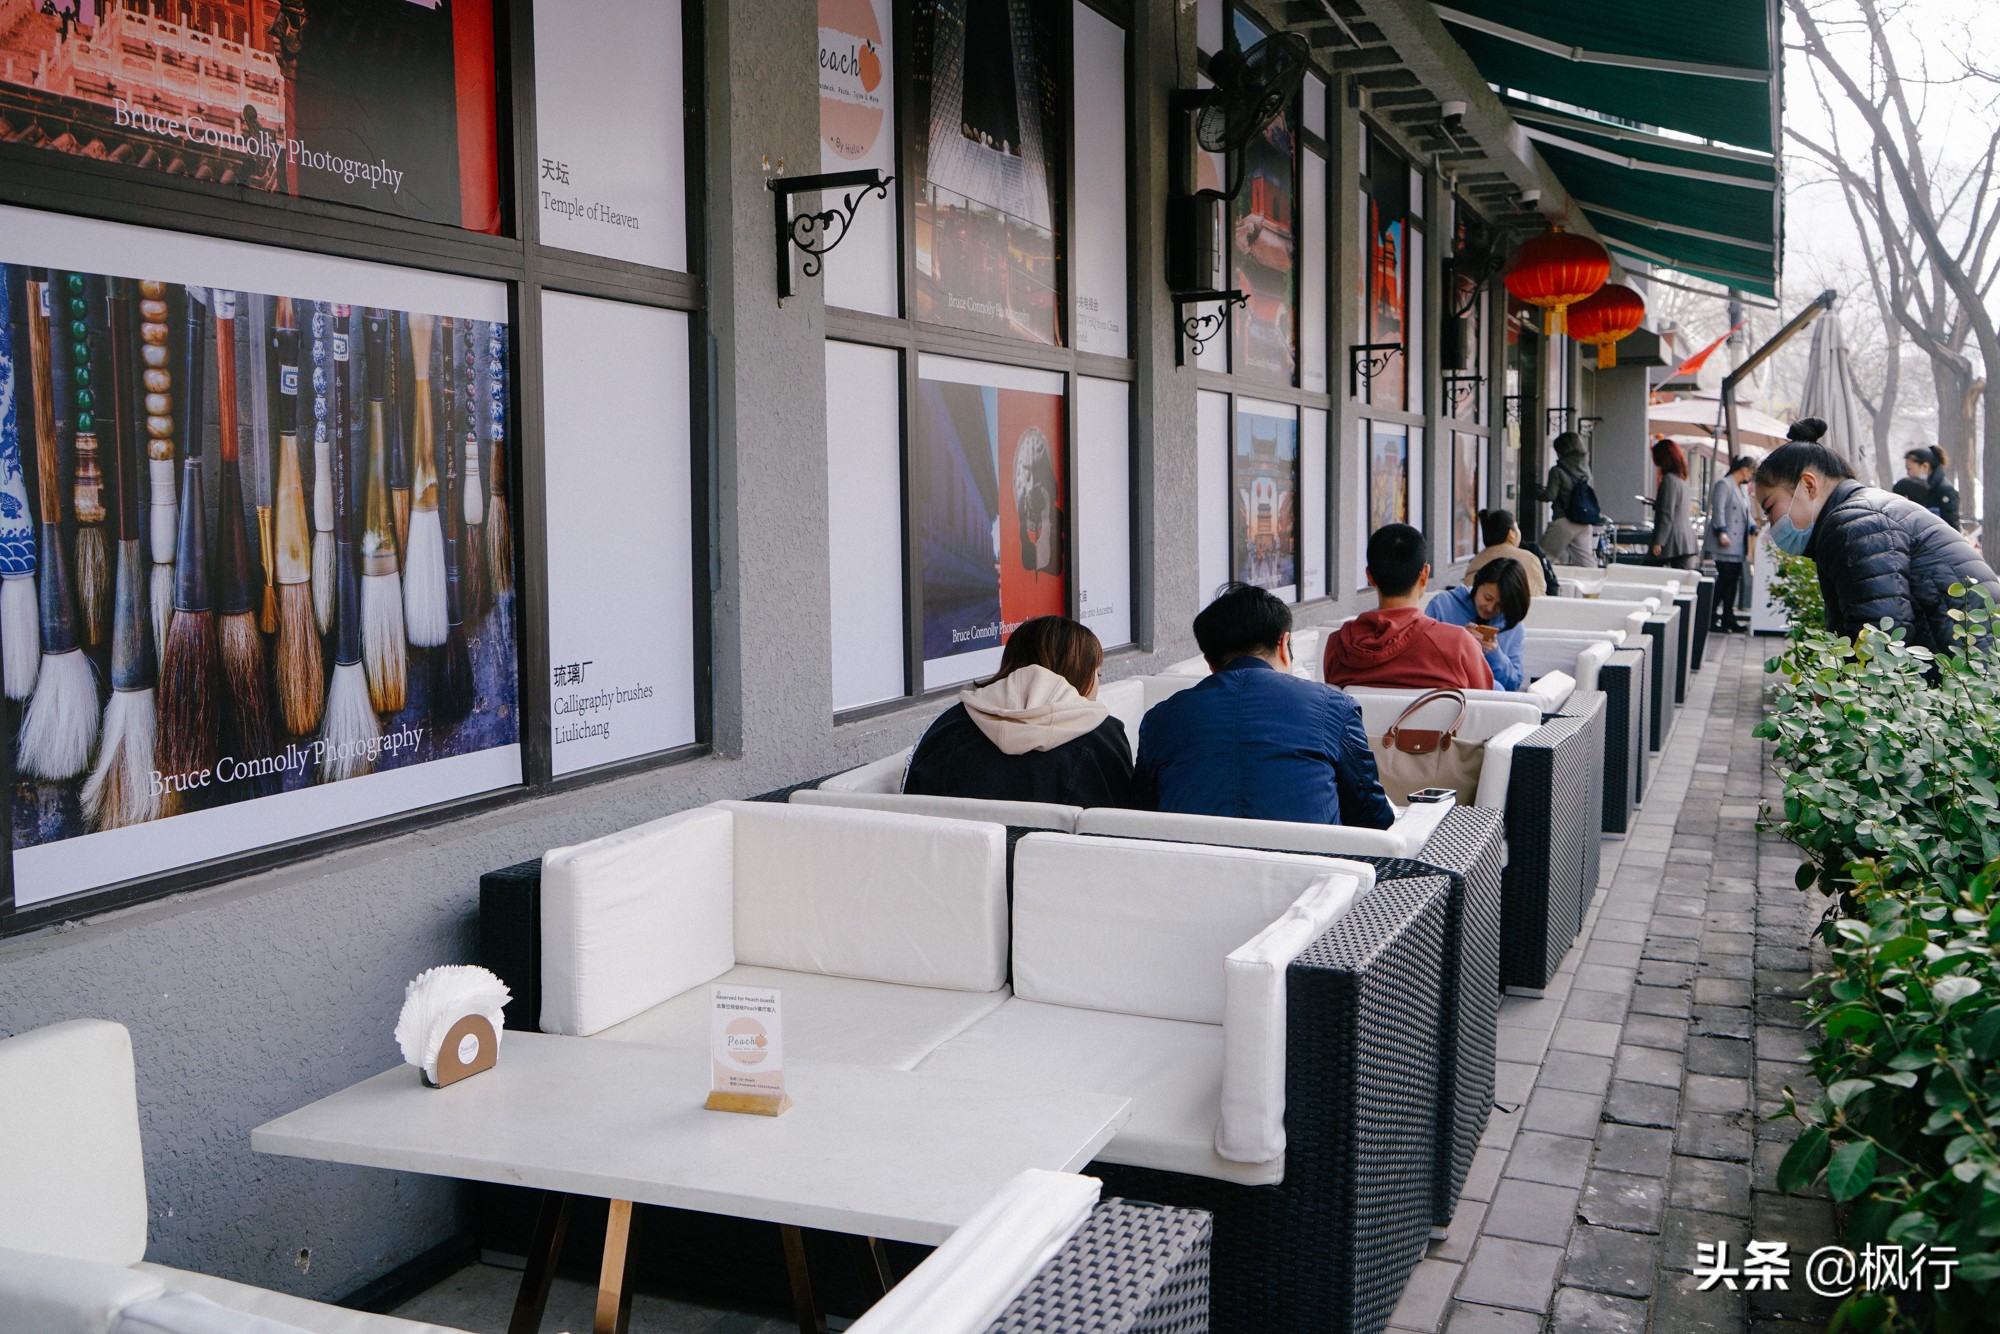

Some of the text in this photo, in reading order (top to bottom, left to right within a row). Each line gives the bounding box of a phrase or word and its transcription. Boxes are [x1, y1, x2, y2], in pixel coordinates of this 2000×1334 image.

[820, 45, 861, 77] each
[112, 98, 404, 193] Bruce Connolly Photography
[542, 158, 570, 186] 天坛
[541, 190, 639, 230] Temple of Heaven
[948, 292, 966, 310] Bruce
[952, 629, 970, 643] Bruce
[970, 621, 998, 640] Connolly
[553, 661, 593, 687] 琉璃厂
[554, 682, 653, 717] Calligraphy brushes
[555, 720, 610, 745] Liulichang
[148, 723, 424, 797] Bruce Connolly Photography
[727, 1035, 755, 1047] Peach
